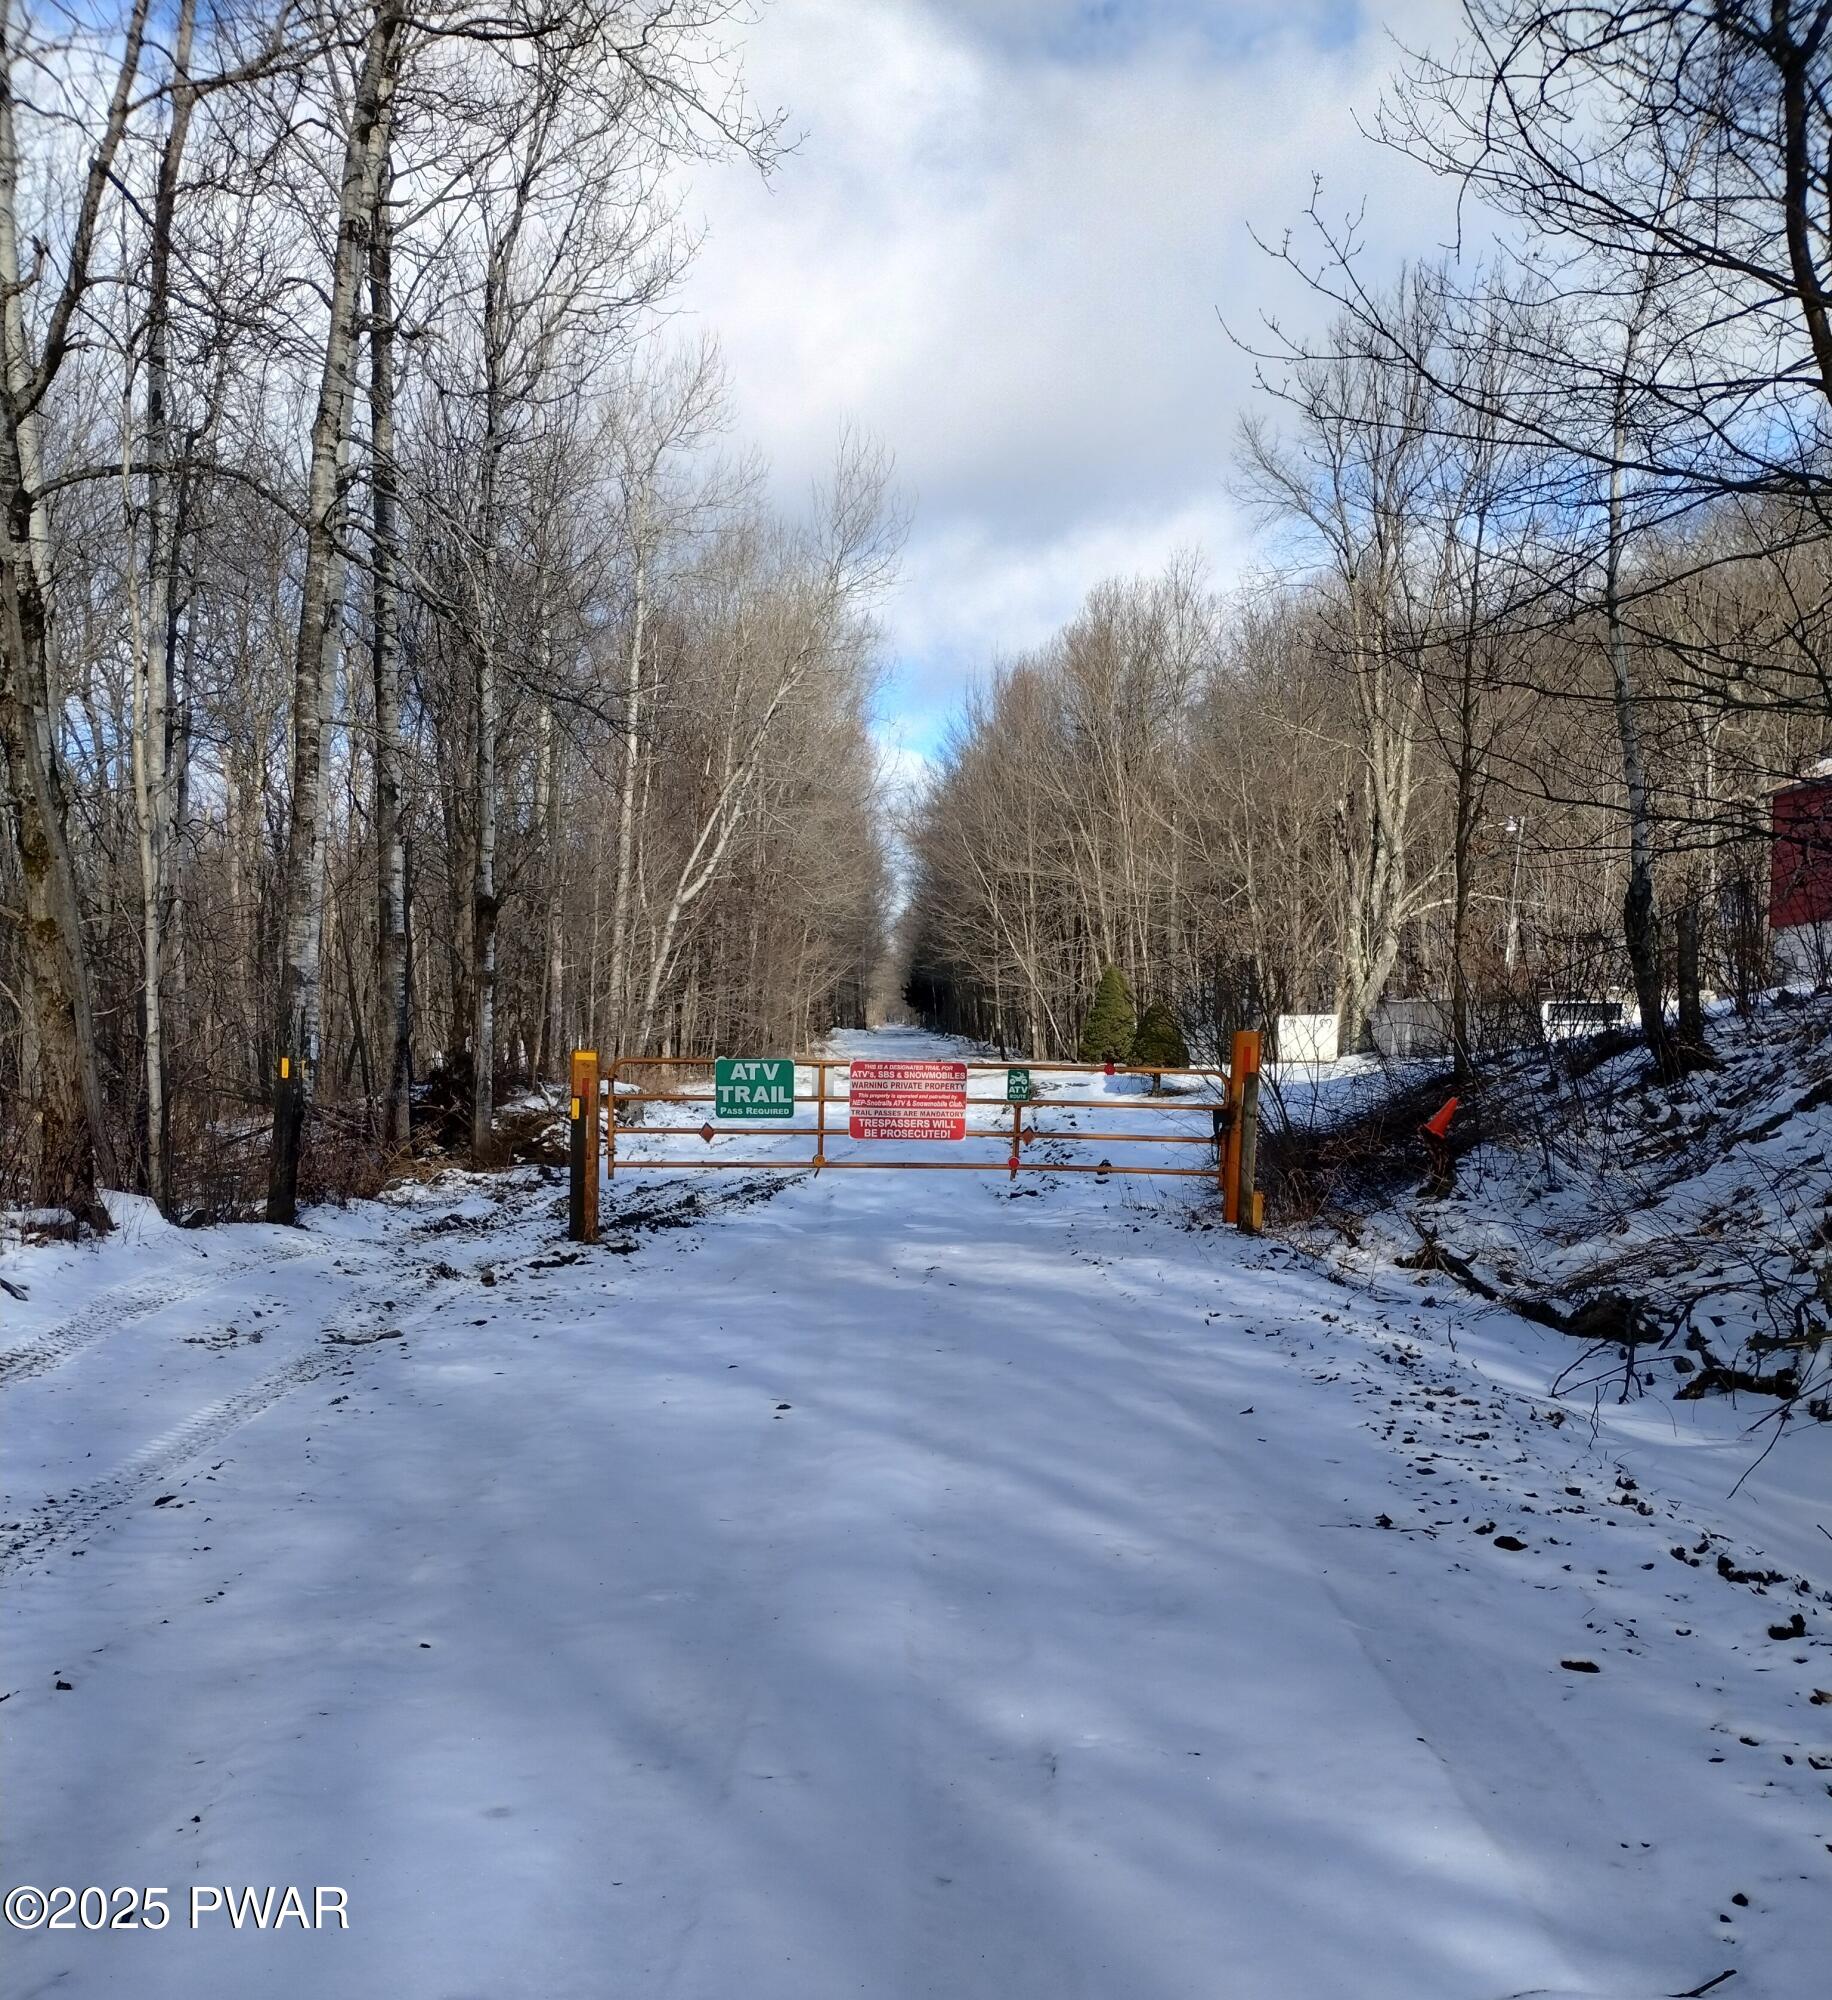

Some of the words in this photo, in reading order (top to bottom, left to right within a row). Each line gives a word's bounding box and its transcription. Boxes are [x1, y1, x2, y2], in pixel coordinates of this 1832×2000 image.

[730, 1063, 779, 1080] ATV
[718, 1086, 791, 1103] TRAIL
[859, 1119, 930, 1127] TRESPASSERS
[932, 1120, 956, 1128] WILL
[880, 1129, 950, 1138] PROSECUTED!
